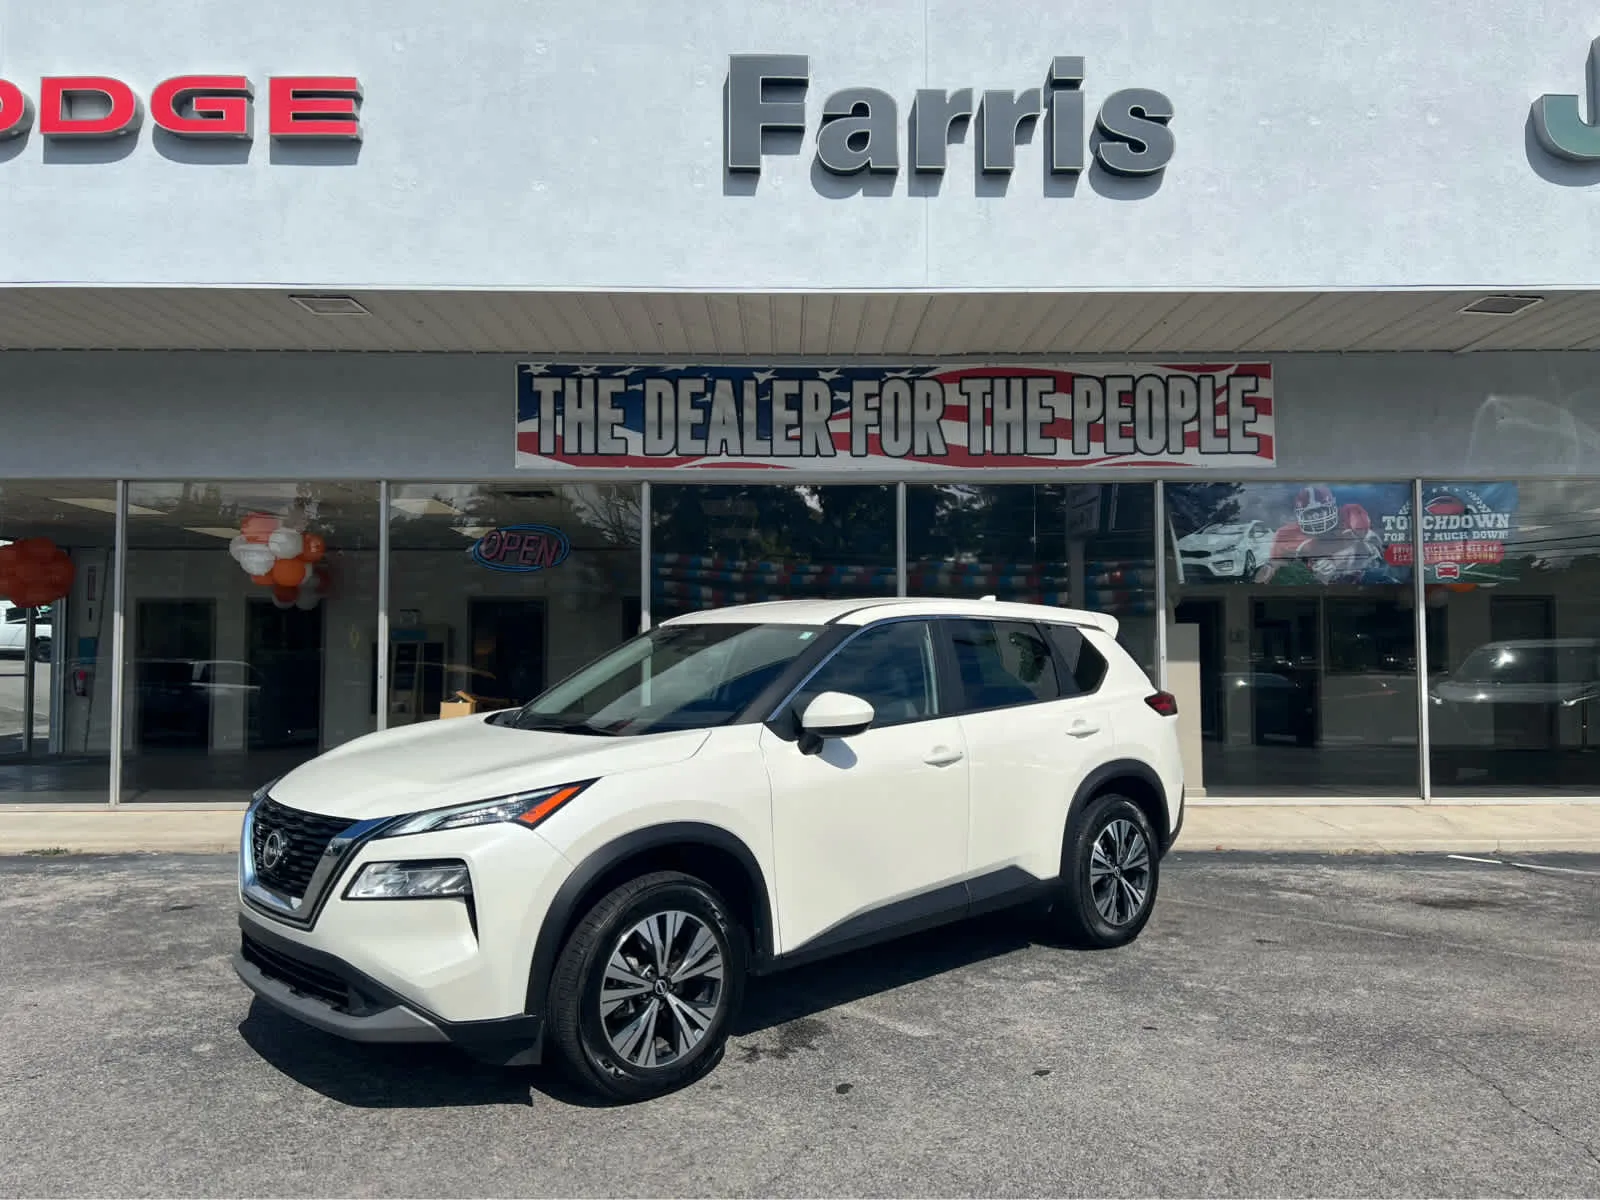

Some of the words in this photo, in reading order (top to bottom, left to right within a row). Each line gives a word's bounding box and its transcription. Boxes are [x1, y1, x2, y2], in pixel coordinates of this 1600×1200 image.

[0, 75, 360, 140] DGE
[727, 54, 1176, 175] Farris
[532, 376, 629, 456] THE
[643, 376, 837, 457] DEALER
[850, 376, 947, 458] FOR
[959, 374, 1057, 456] THE
[1072, 373, 1260, 456] PEOPLE
[1382, 514, 1510, 530] TOCHDOWN
[1383, 532, 1405, 541] FOR
[1434, 532, 1468, 541] MUCH
[479, 530, 559, 568] OPEN
